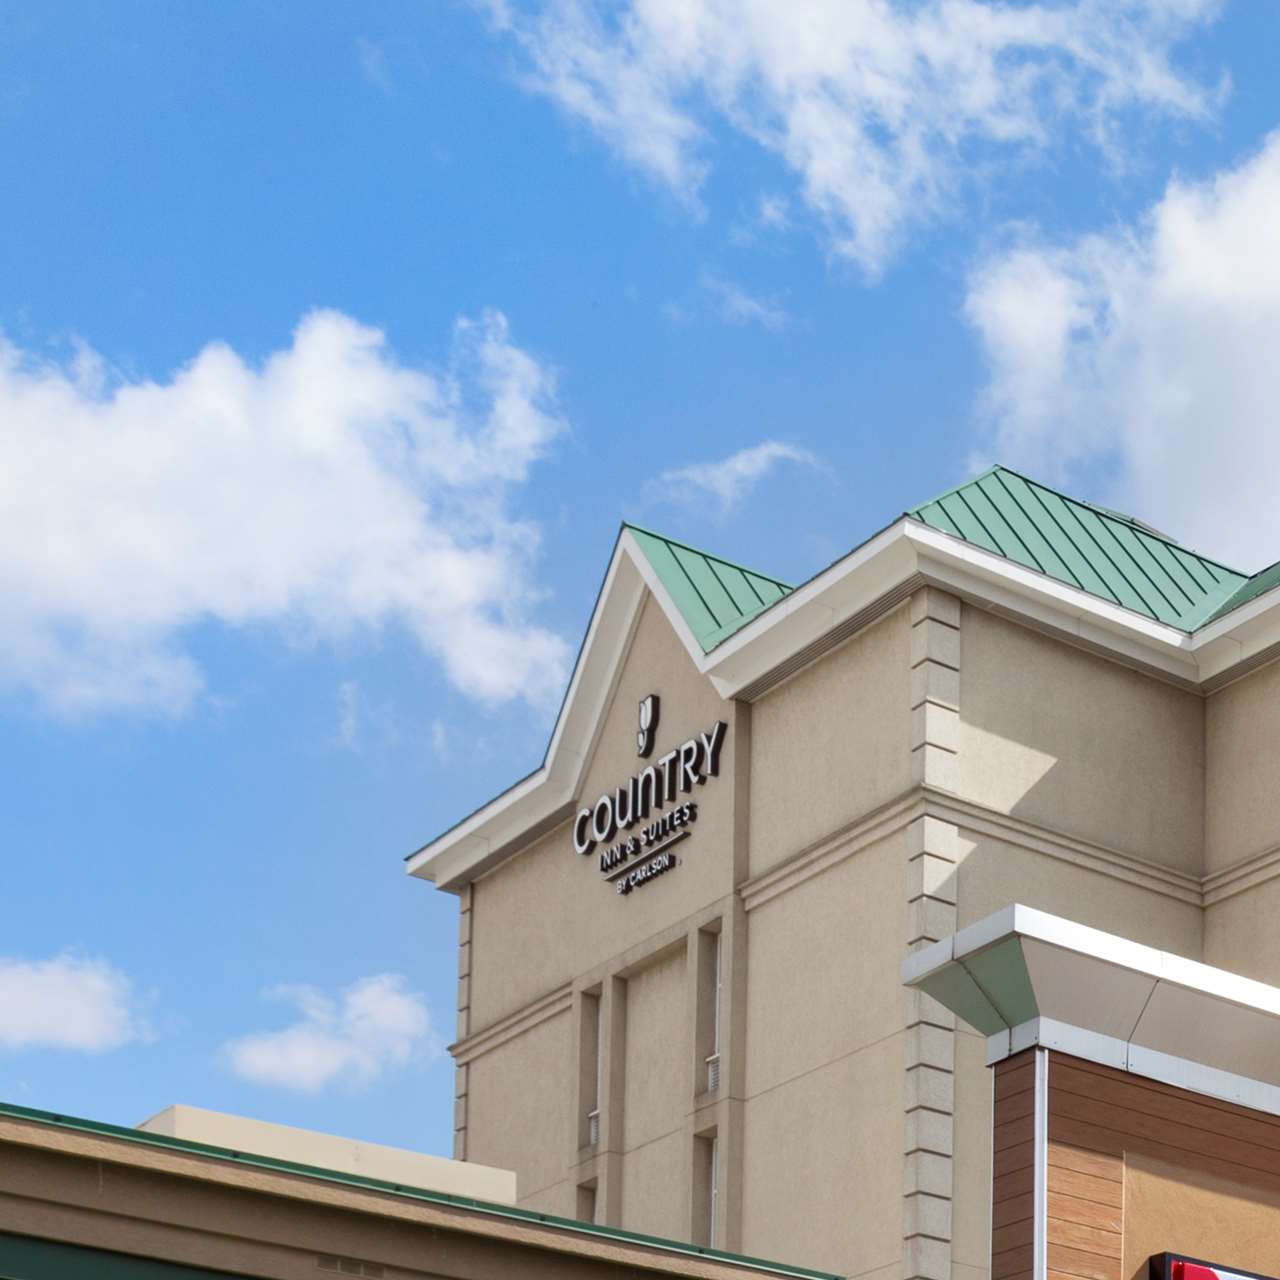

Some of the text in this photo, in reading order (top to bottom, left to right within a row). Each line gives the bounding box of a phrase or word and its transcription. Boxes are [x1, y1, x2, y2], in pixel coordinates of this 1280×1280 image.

[600, 802, 695, 872] INN & SUITES
[616, 853, 675, 895] BY CARLSON
